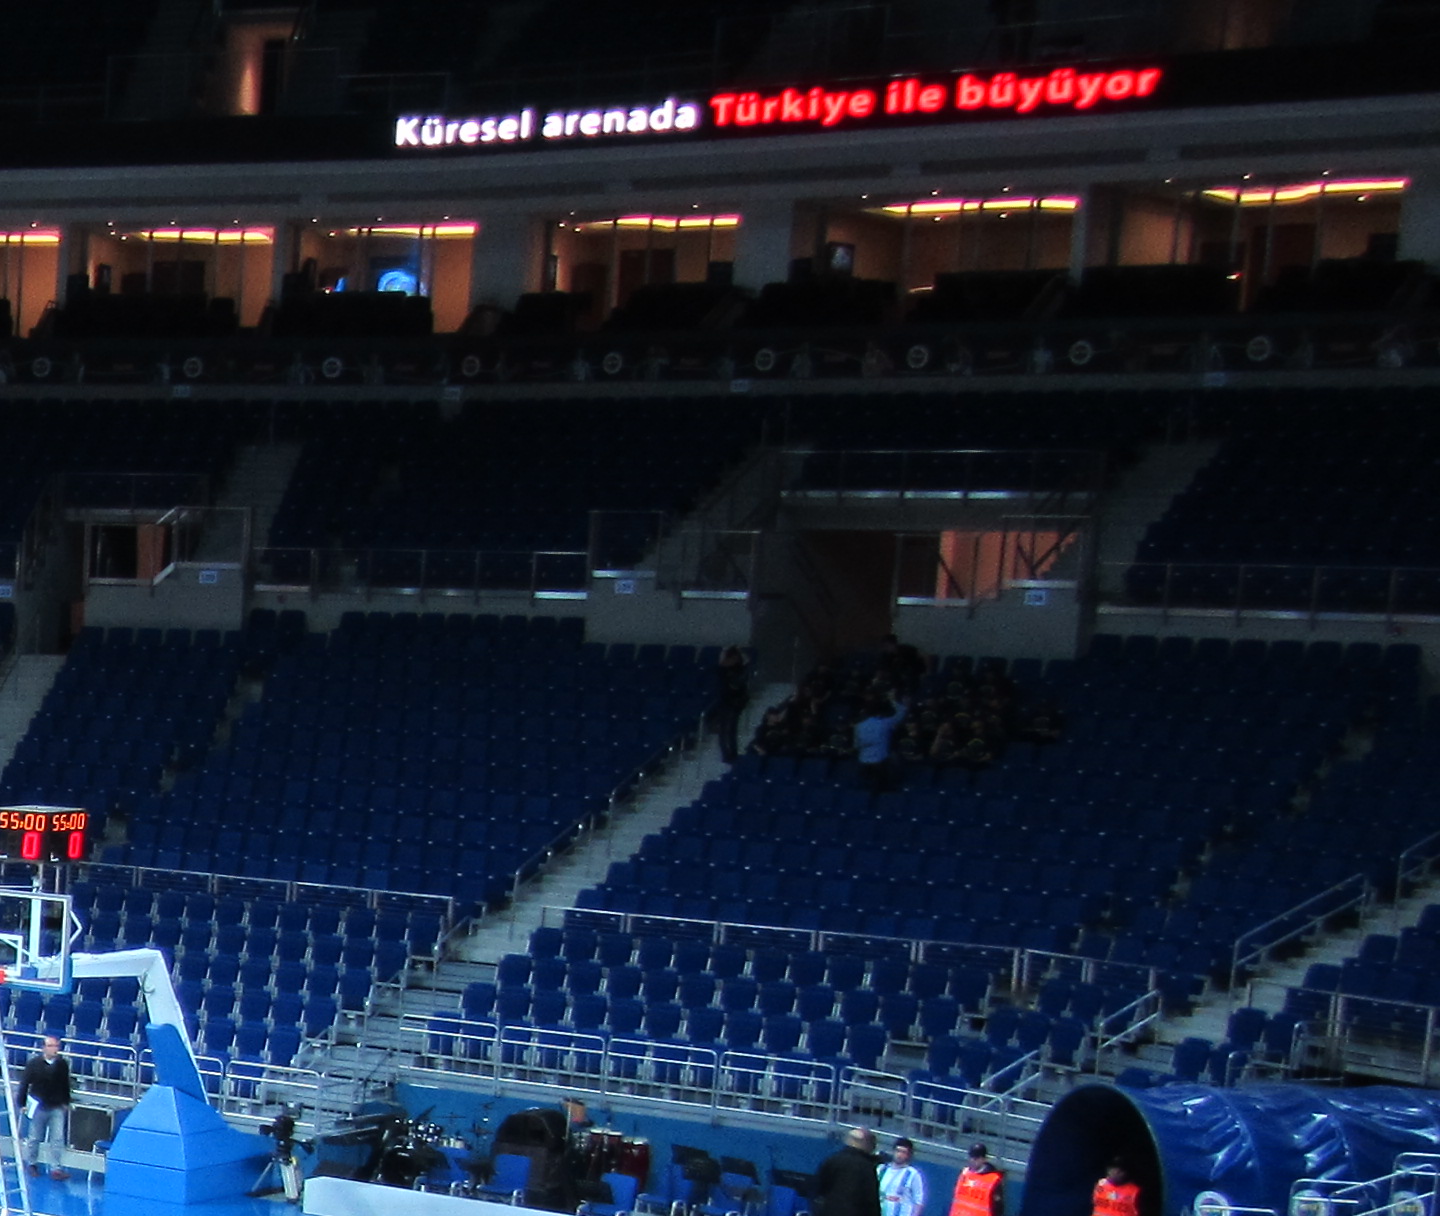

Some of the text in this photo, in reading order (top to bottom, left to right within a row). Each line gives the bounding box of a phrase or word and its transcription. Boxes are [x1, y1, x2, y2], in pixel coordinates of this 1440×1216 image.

[393, 67, 1163, 148] Küresel arenada Türkiye ile büyüyor
[0, 811, 86, 832] 55:00 55:00
[22, 831, 40, 859] 0
[67, 831, 84, 859] 0
